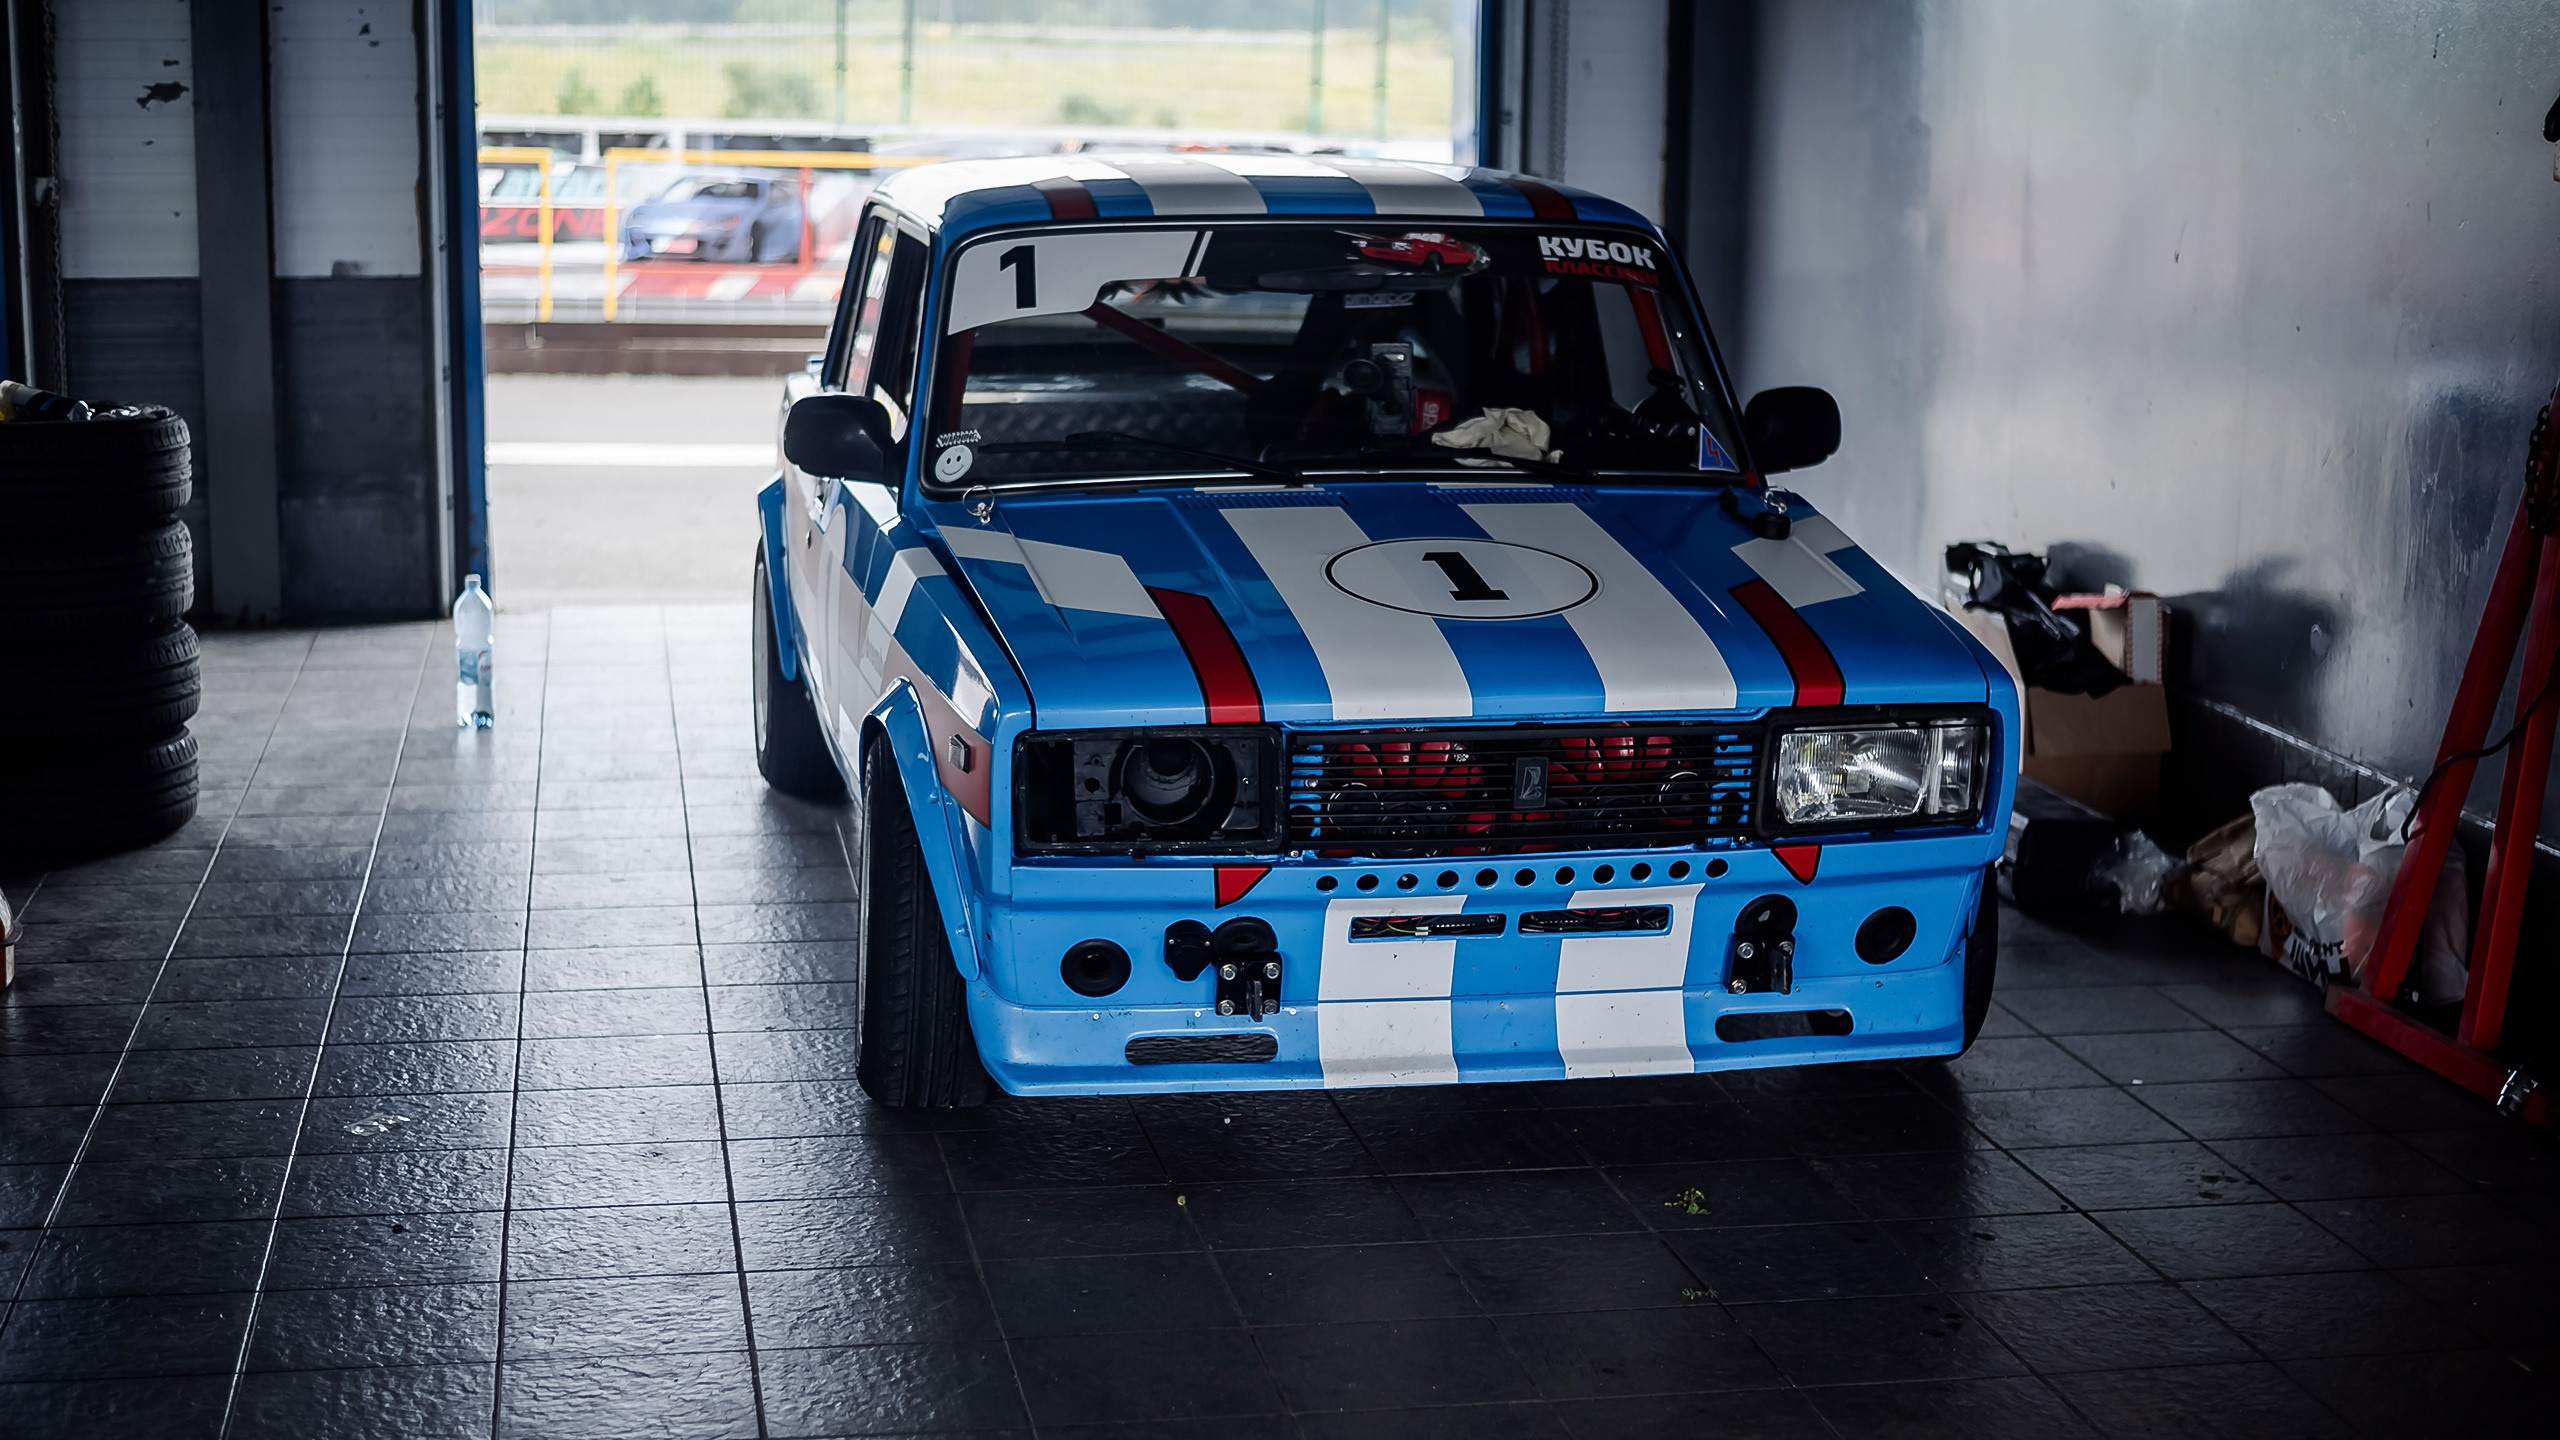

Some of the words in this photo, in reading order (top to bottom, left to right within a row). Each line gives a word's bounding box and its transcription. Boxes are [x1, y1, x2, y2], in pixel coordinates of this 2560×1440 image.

[1538, 235, 1656, 270] КУБОК
[1545, 260, 1660, 286] КЛАССИКИ
[1000, 245, 1037, 309] 1
[1421, 551, 1510, 601] 1
